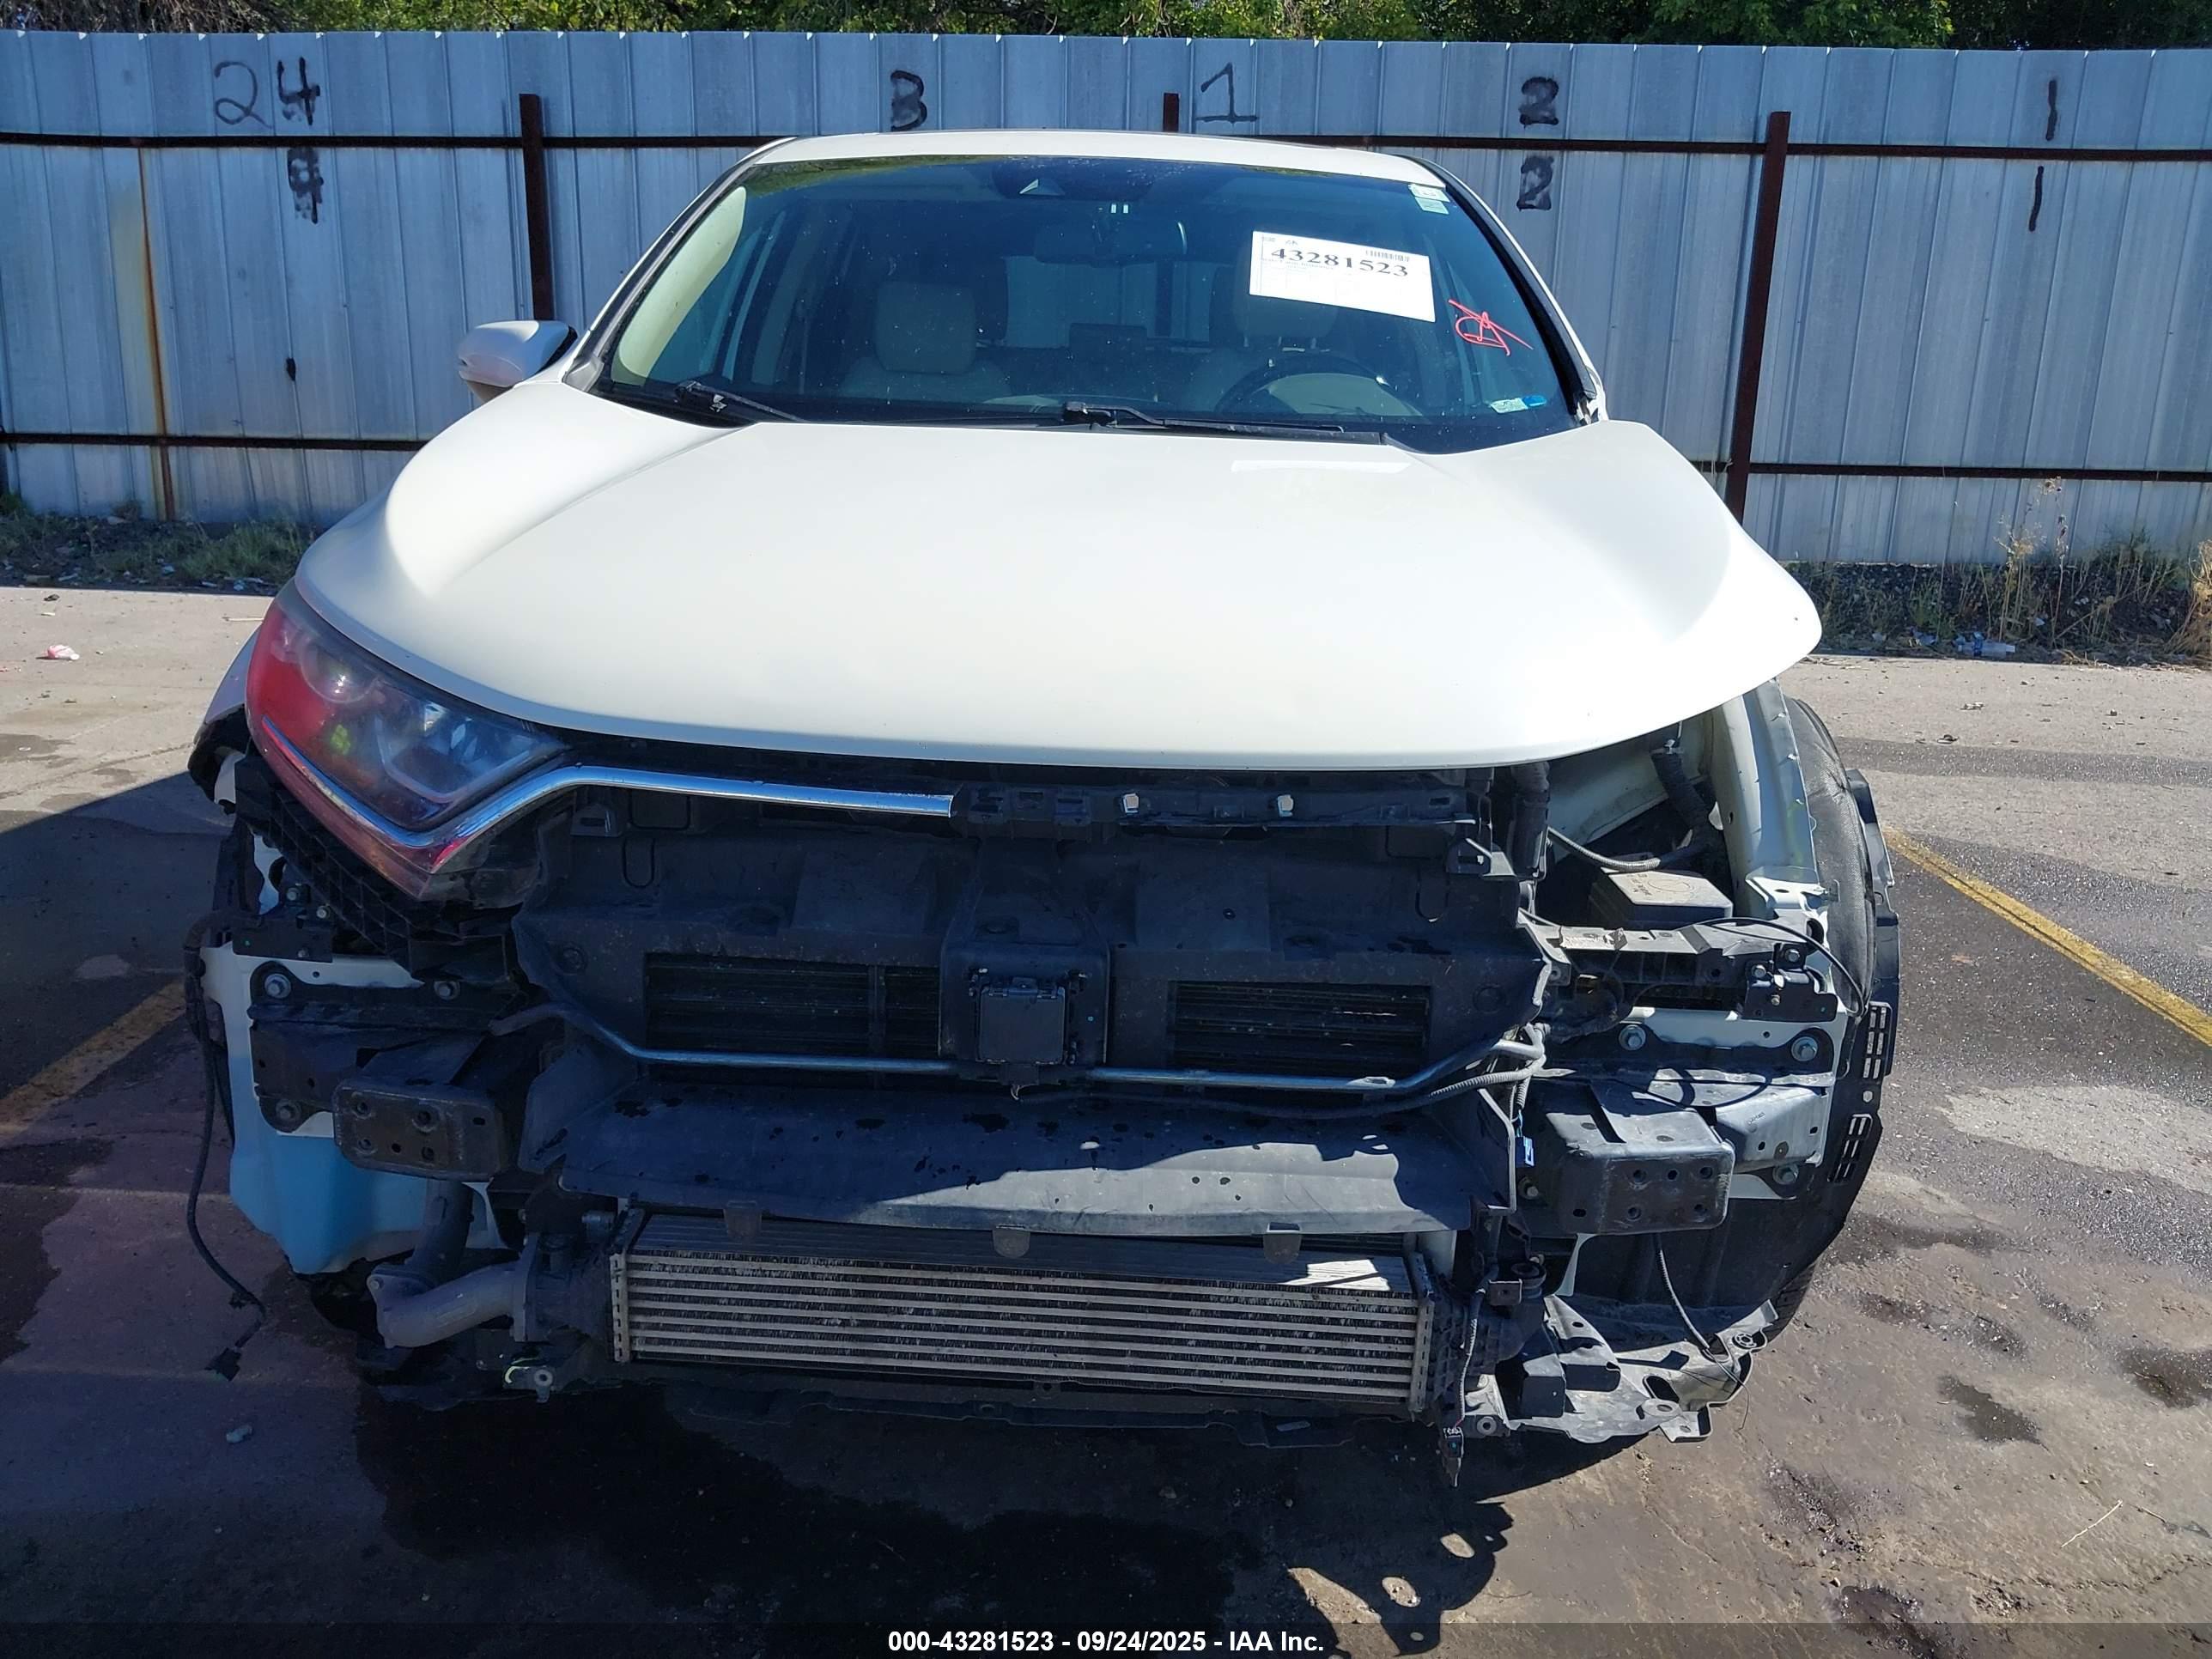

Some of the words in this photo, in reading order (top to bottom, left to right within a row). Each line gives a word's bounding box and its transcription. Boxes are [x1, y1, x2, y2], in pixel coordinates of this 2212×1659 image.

[1195, 62, 1259, 124] 1
[1518, 76, 1559, 126] 2
[1516, 155, 1554, 211] 2
[1271, 247, 1409, 277] 43281523
